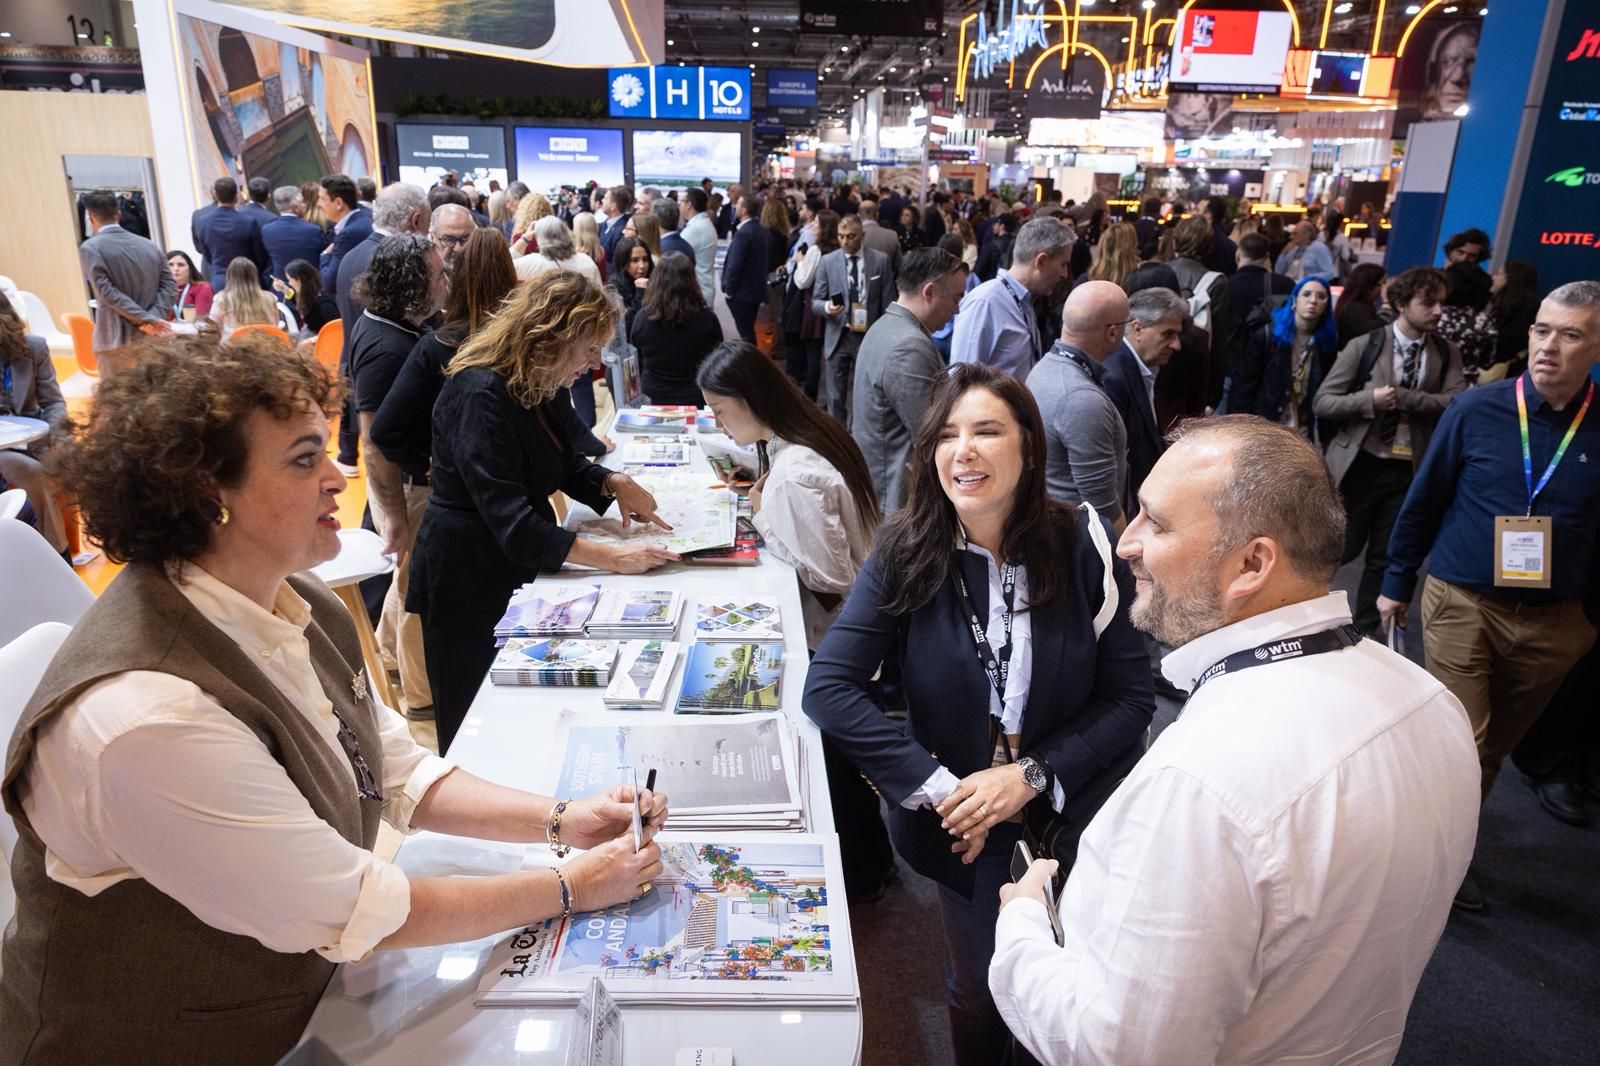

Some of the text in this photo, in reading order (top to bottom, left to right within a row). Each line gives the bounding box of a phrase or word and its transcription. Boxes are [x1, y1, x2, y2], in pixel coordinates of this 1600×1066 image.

[666, 79, 743, 107] H 10
[712, 106, 742, 115] HOTELS
[1540, 232, 1594, 245] LOTTE
[976, 624, 985, 643] wtm
[1268, 640, 1302, 655] wtm
[1205, 662, 1225, 679] wtm
[570, 744, 592, 792] SOUTHERN
[588, 752, 607, 784] SPAIN
